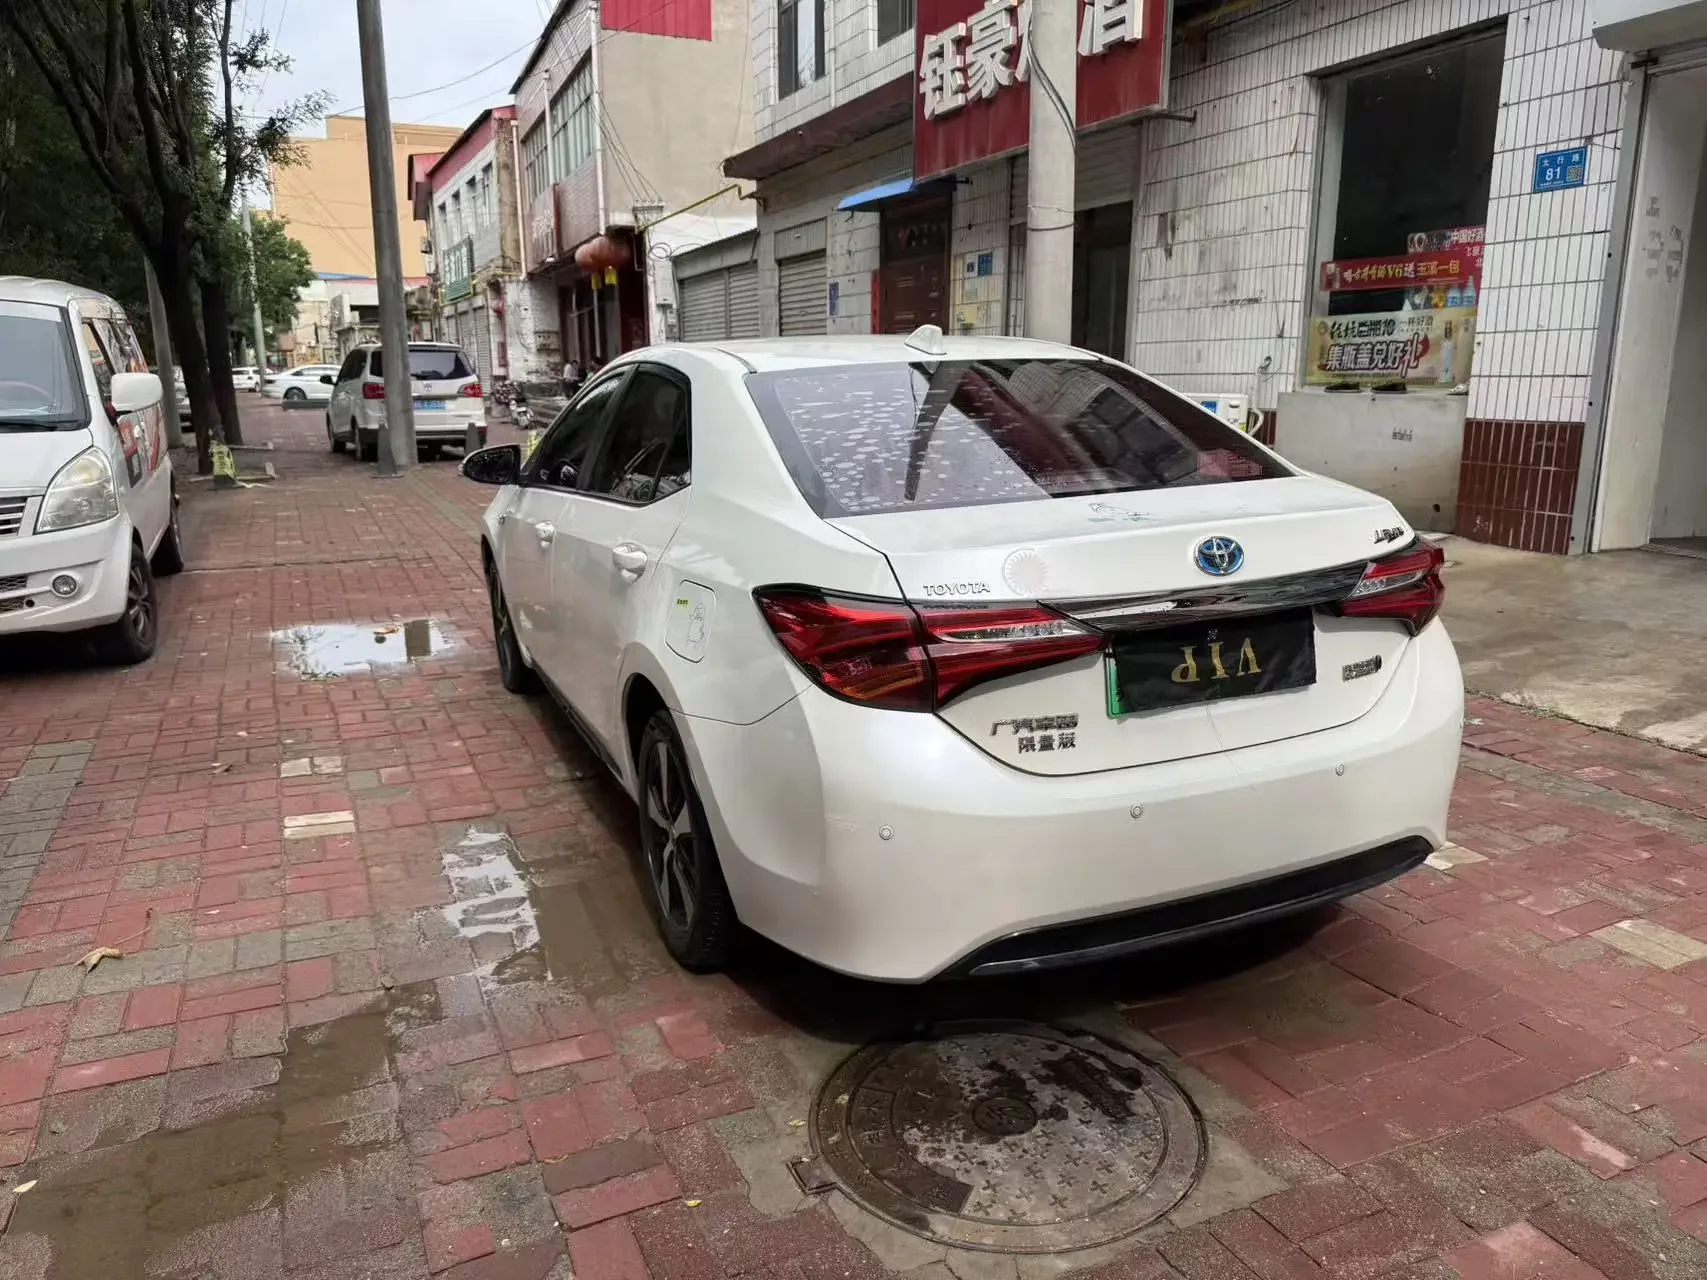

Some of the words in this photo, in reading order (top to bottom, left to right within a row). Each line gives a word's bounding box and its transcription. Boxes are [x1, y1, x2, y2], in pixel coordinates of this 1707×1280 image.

[1545, 167, 1561, 181] 81
[1326, 333, 1419, 378] 集瓶盖兑好礼
[923, 582, 991, 596] TOYOTA
[1171, 638, 1262, 683] VIP
[1018, 731, 1076, 754] 限量版
